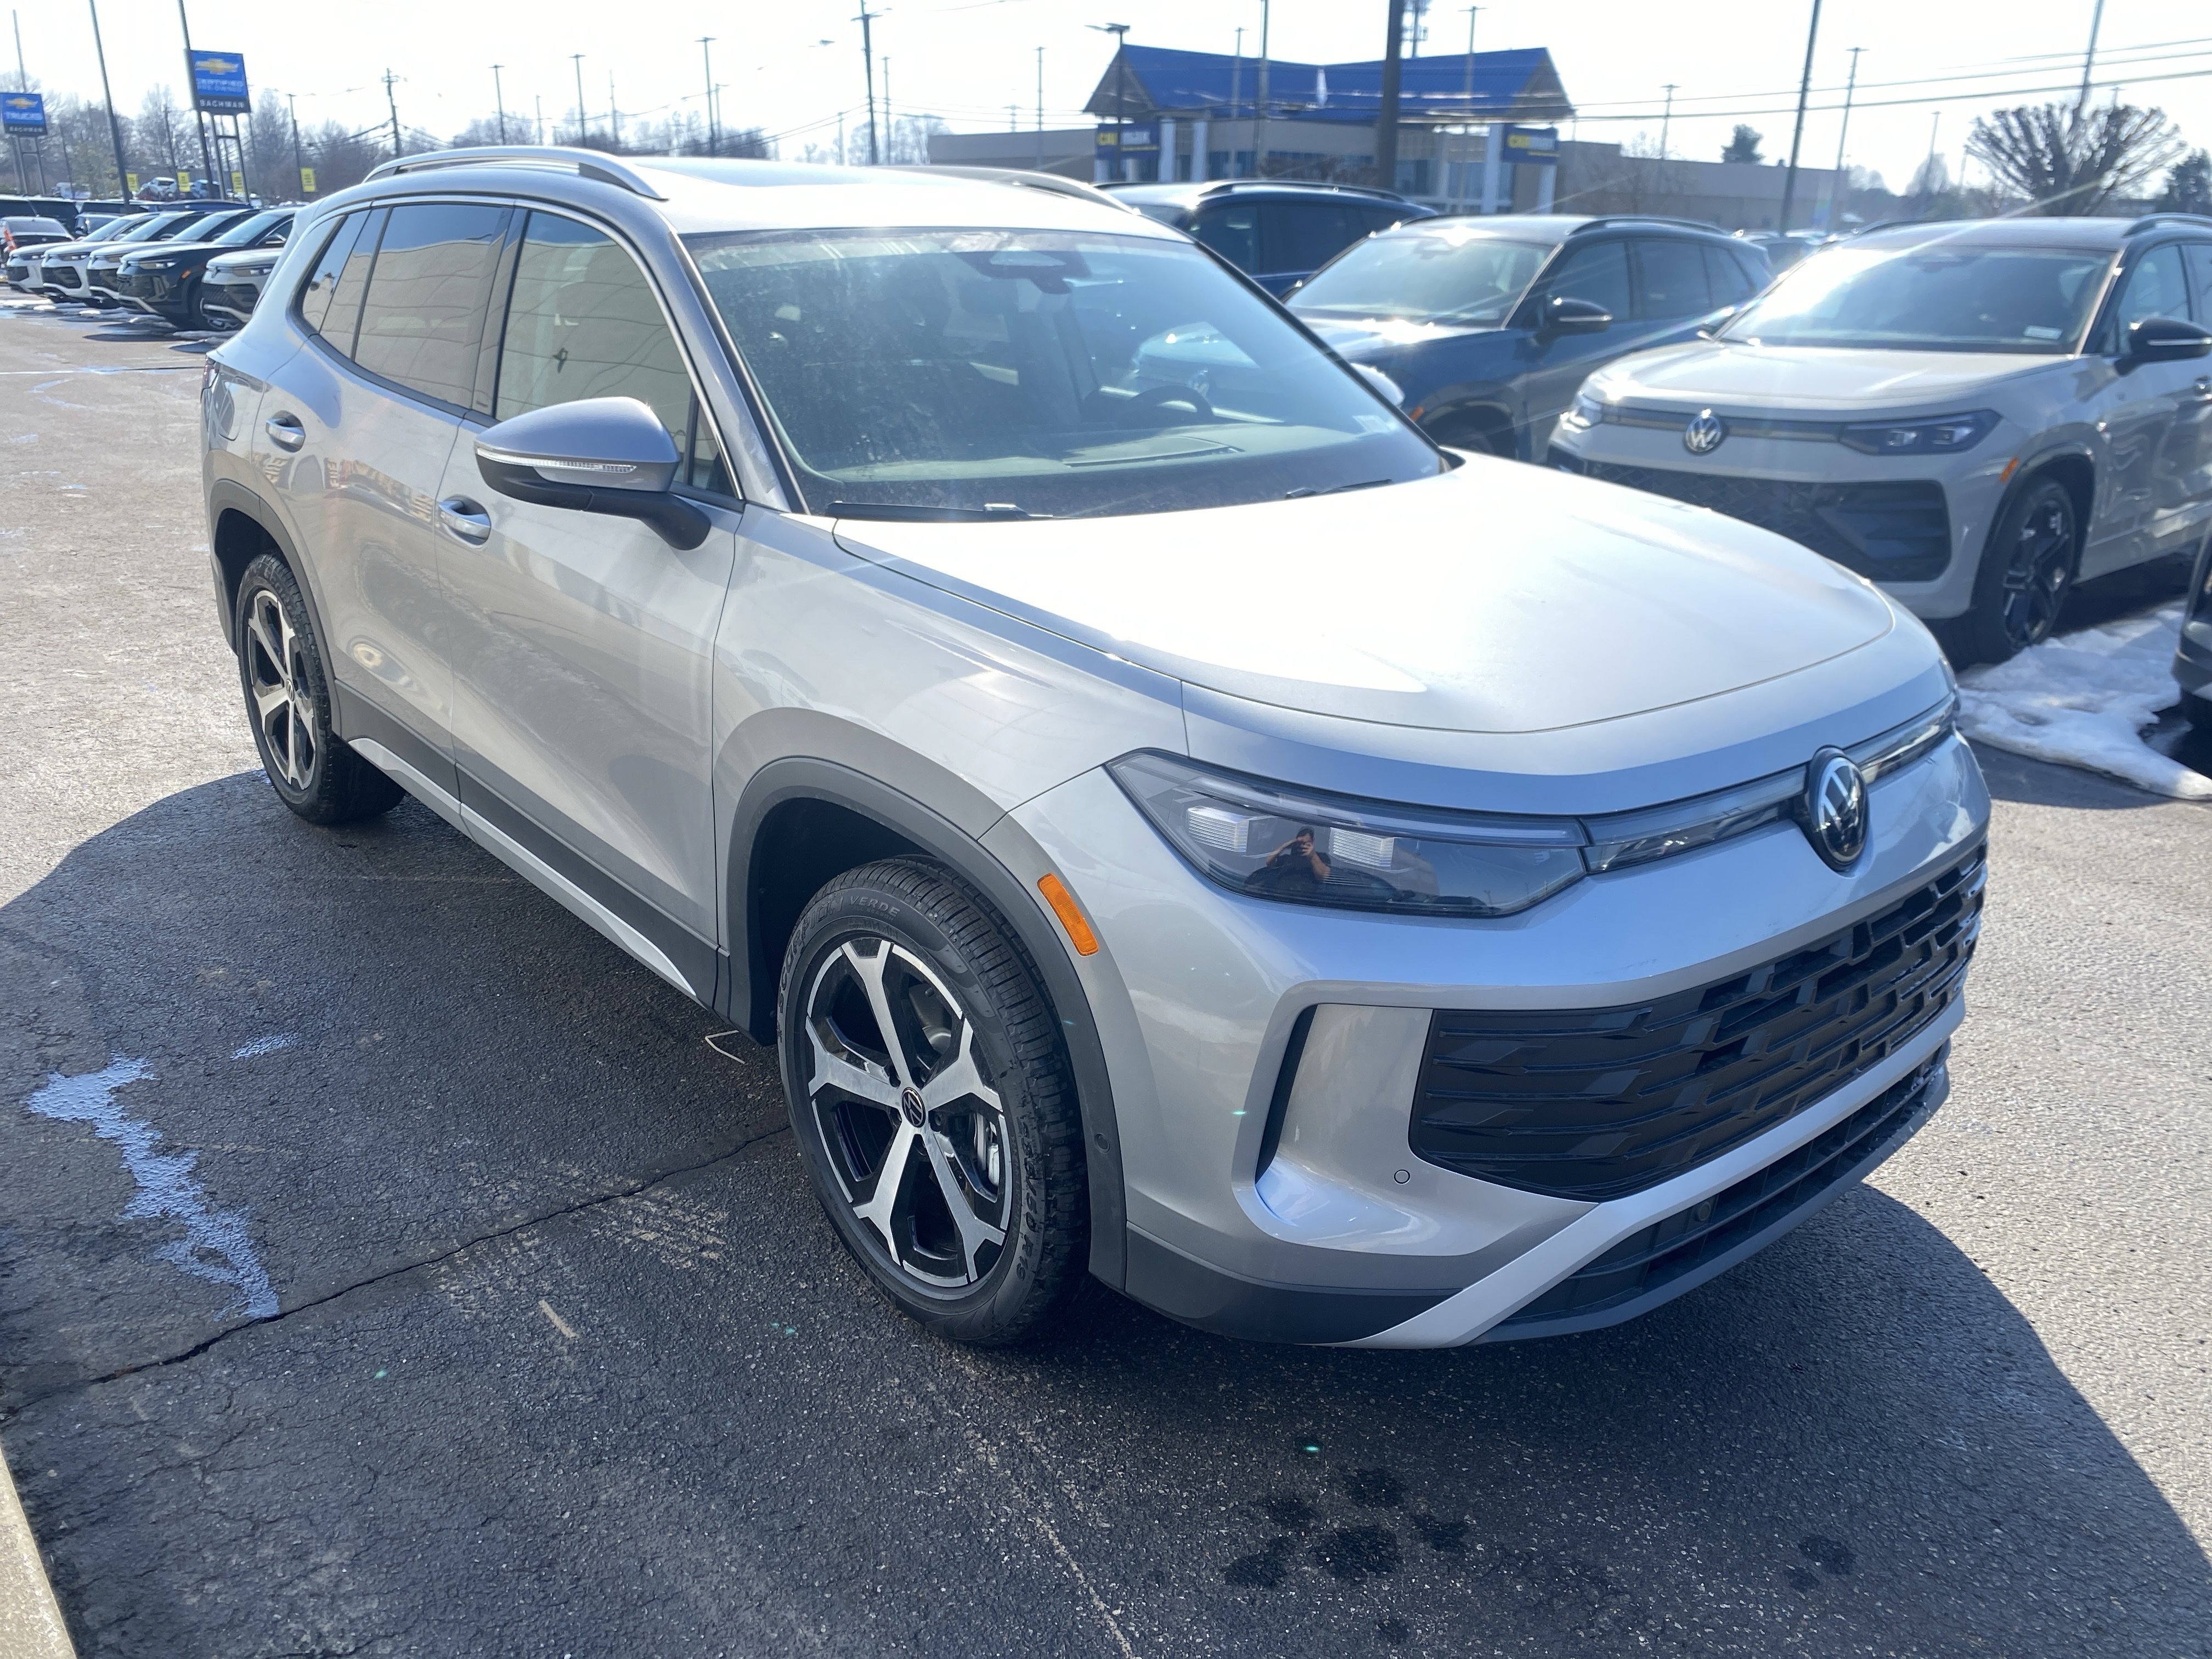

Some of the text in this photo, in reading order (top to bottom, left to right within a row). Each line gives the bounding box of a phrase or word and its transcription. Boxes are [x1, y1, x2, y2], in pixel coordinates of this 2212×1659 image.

[200, 99, 245, 108] BACHMAN
[850, 895, 900, 917] VERDE
[1016, 1234, 1034, 1282] R19
